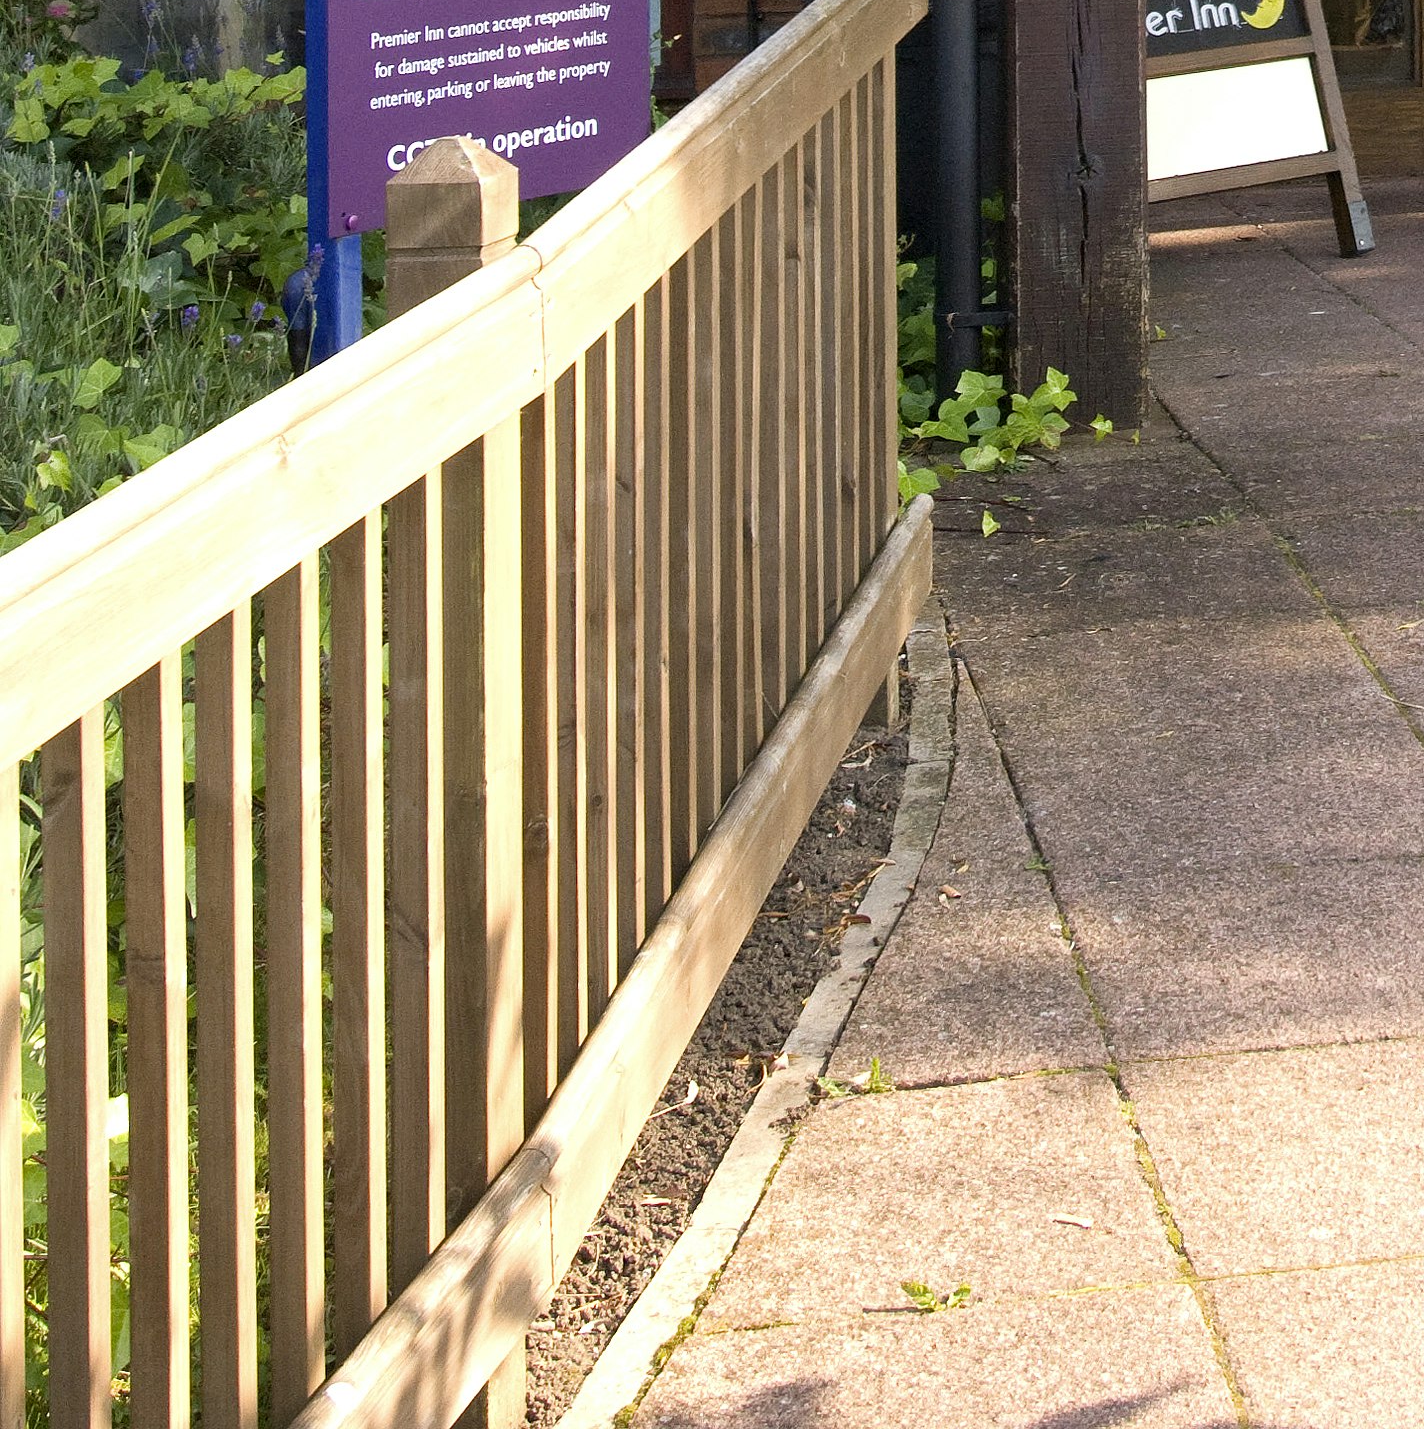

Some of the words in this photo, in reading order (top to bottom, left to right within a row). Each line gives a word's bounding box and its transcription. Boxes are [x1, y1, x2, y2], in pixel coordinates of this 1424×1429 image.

[370, 29, 421, 50] Premier
[424, 25, 444, 42] Inn
[447, 20, 490, 39] cannot
[492, 14, 532, 33] accept
[534, 1, 611, 28] responsibility
[374, 61, 395, 79] for
[397, 57, 445, 75] damage
[447, 43, 504, 68] sustained
[507, 45, 521, 58] to
[524, 35, 570, 56] vehicles
[572, 29, 608, 48] whilst
[370, 88, 426, 110] entering,
[426, 81, 473, 106] parking
[475, 79, 491, 93] or
[493, 71, 534, 89] leaving
[536, 66, 557, 83] the
[559, 61, 611, 84] property
[492, 115, 598, 158] operation
